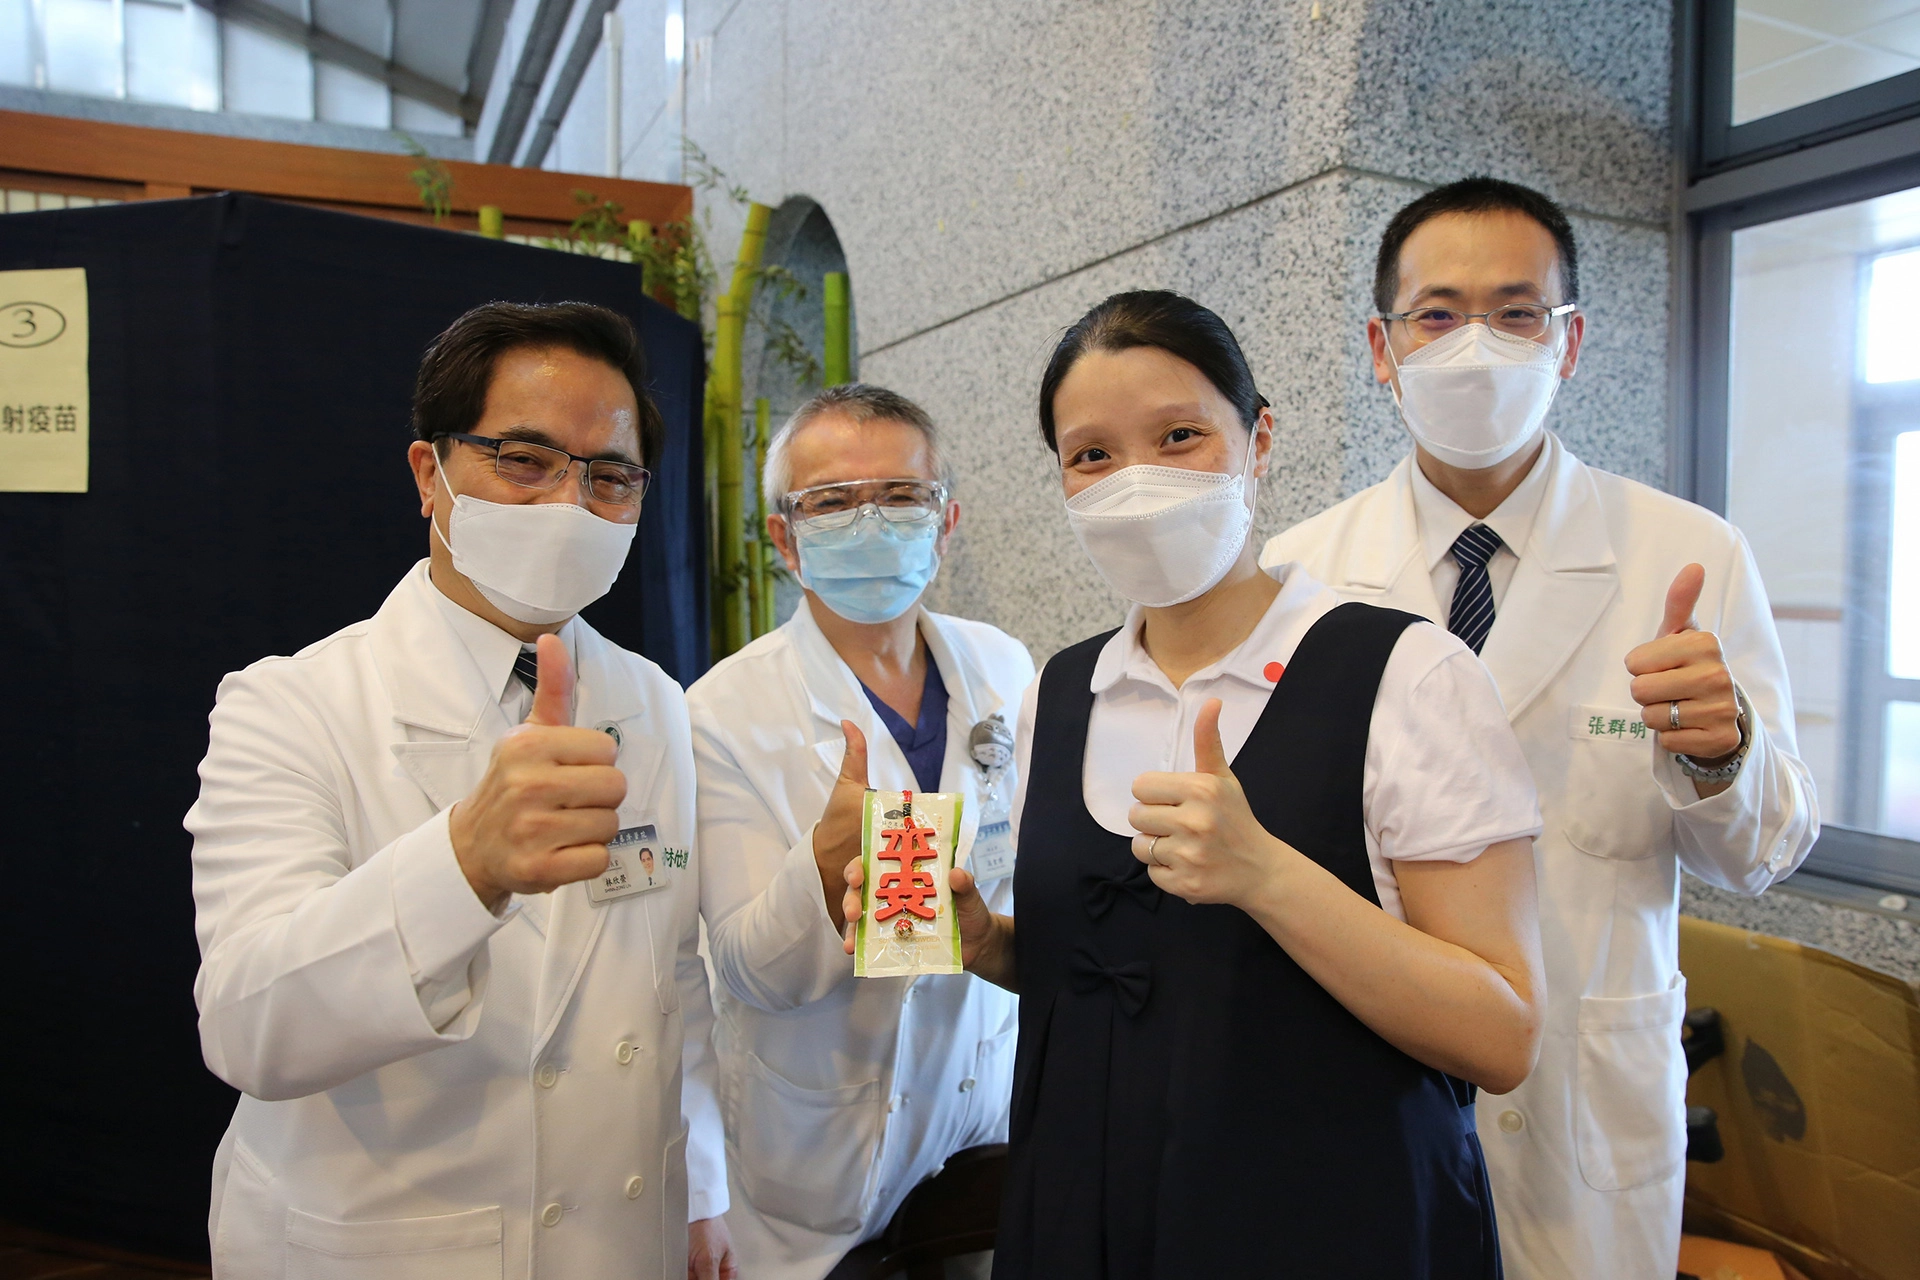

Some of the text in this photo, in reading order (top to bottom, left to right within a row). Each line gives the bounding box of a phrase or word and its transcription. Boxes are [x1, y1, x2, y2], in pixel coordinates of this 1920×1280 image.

[12, 308, 37, 339] 3
[2, 404, 78, 434] 射疫苗
[1588, 716, 1647, 739] 張群明
[875, 827, 938, 922] 平安
